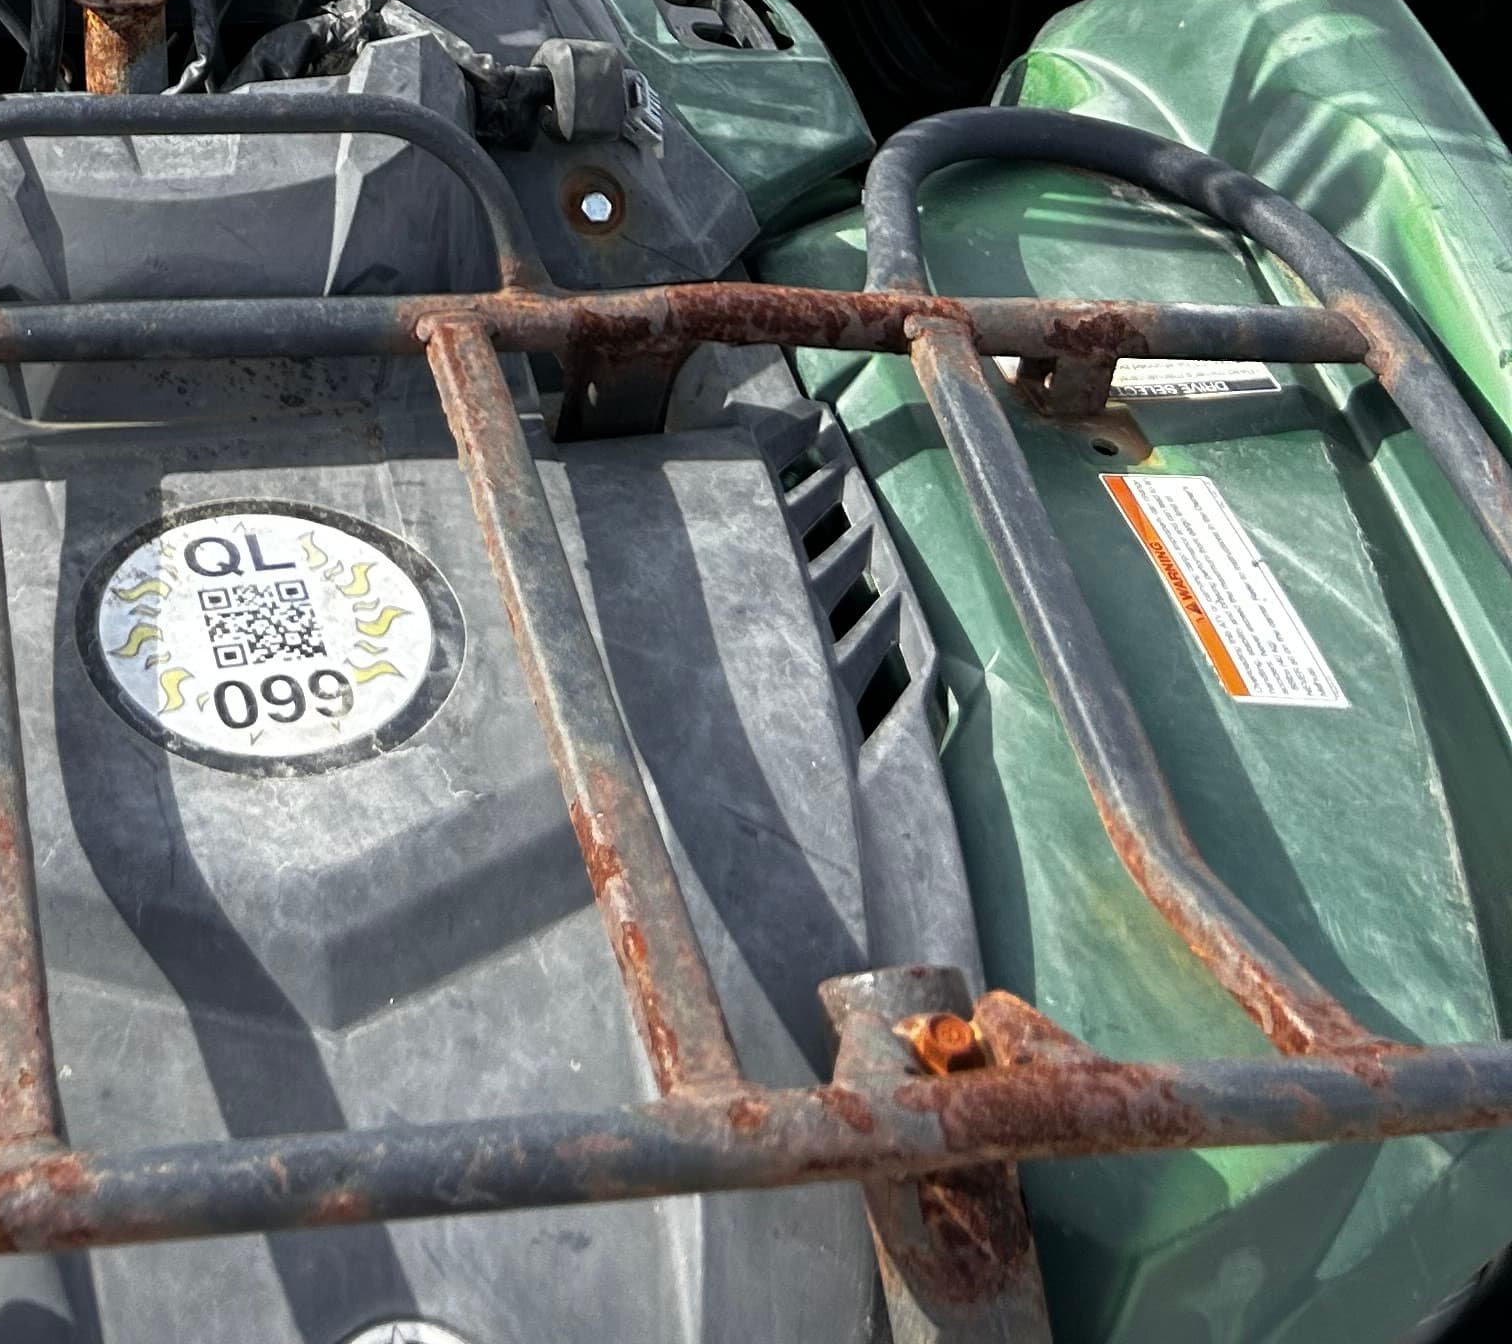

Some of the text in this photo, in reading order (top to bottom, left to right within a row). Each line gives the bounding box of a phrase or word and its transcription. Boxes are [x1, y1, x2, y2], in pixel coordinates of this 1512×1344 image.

[1182, 380, 1230, 395] DRIVE
[183, 532, 297, 578] QL
[1149, 541, 1193, 601] WARNING
[213, 668, 355, 730] 099
